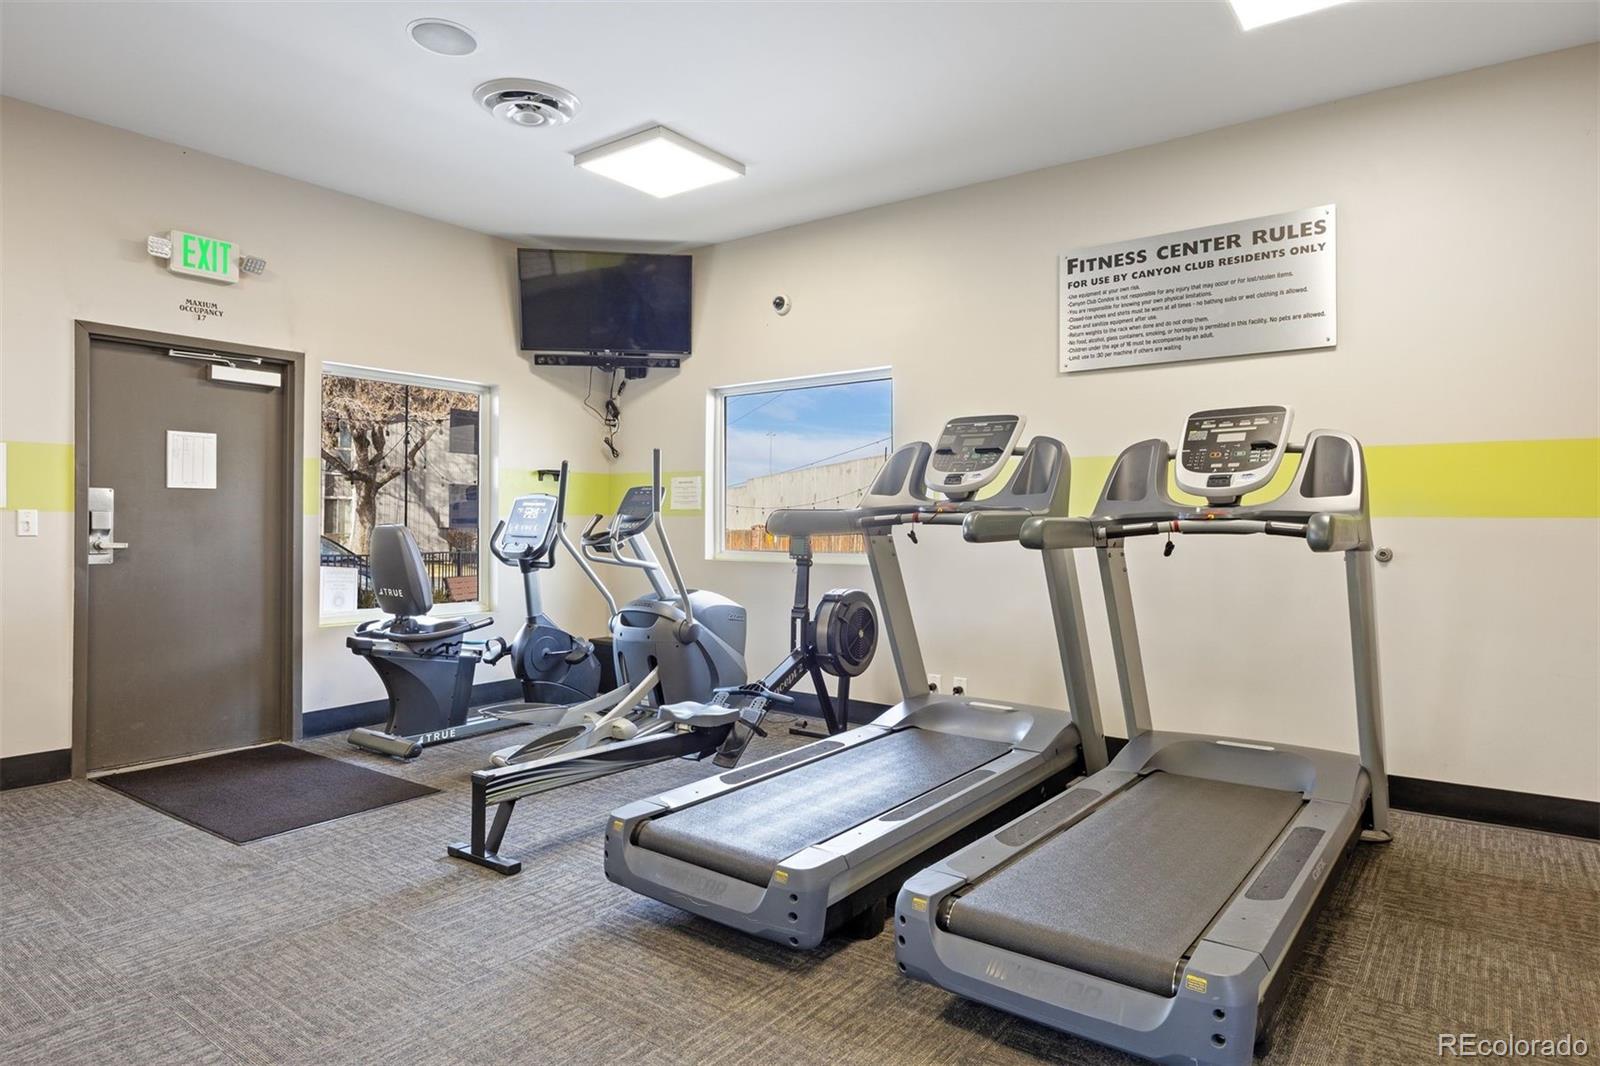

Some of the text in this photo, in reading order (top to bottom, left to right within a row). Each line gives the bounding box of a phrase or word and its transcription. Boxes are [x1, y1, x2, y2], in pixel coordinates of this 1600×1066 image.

[1067, 219, 1326, 275] FITNESS CENTER RULES
[183, 234, 232, 275] EXIT
[1067, 242, 1326, 289] FOR USE BY CANYON CLUB RESIDENTS ONLY
[1078, 290, 1100, 298] equipment
[1129, 290, 1155, 299] responsible
[1175, 285, 1189, 293] injury
[1204, 297, 1222, 305] bathing
[1256, 290, 1277, 298] clothing
[1285, 286, 1307, 294] allowed.
[185, 299, 218, 310] MAXIUM
[1087, 305, 1111, 313] responsible
[1185, 291, 1211, 299] limitations.
[179, 305, 224, 317] OCCUPANCY
[1110, 317, 1133, 325] equipment
[1174, 326, 1197, 334] horseplay
[1205, 322, 1229, 330] permitted
[1152, 335, 1183, 344] accompanied
[383, 588, 404, 598] TRUE
[426, 729, 456, 742] TRUE
